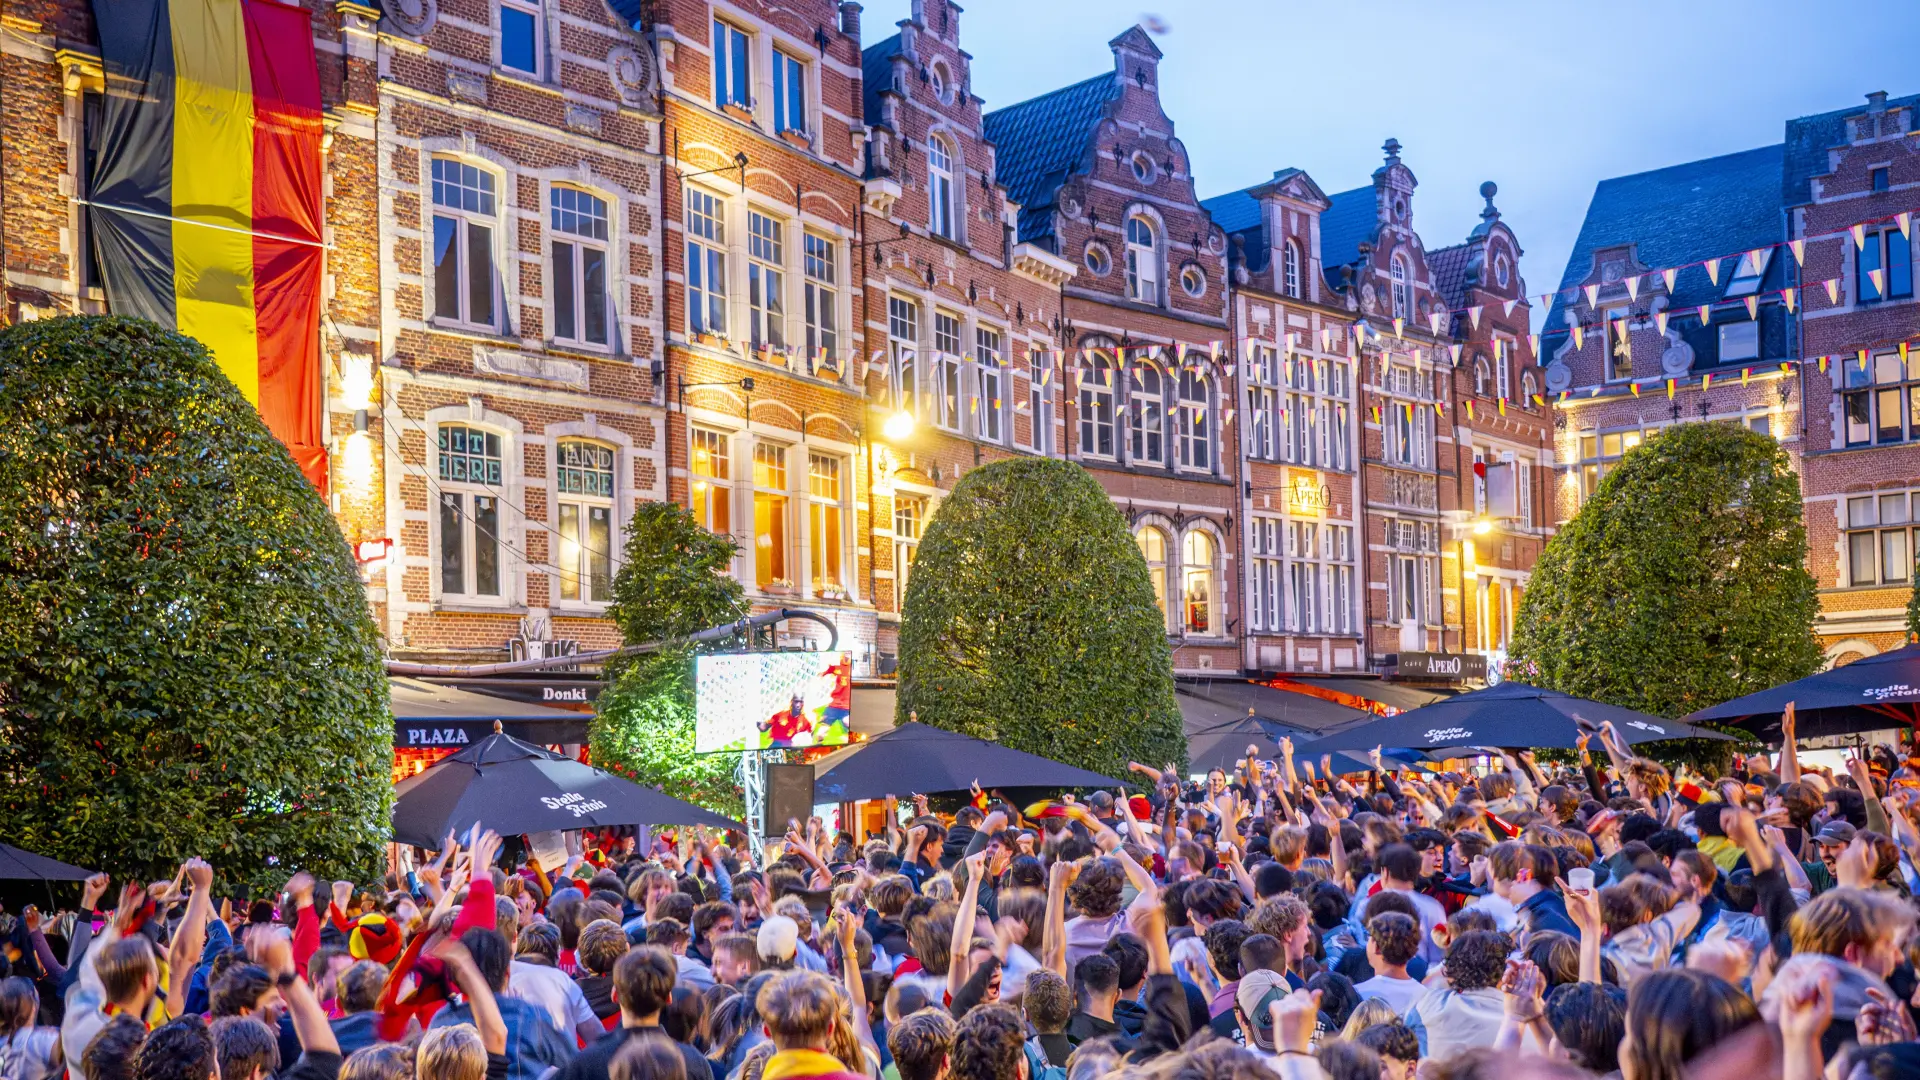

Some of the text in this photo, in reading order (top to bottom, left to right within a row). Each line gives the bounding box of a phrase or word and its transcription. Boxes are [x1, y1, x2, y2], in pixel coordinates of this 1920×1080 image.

[438, 430, 483, 453] SIT
[567, 447, 611, 468] AND
[1427, 656, 1461, 674] APERO
[543, 687, 587, 700] Donki
[1862, 684, 1909, 697] Stella
[408, 728, 469, 744] PLAZA
[1423, 727, 1464, 738] Stella
[1428, 731, 1473, 743] Artois
[540, 792, 585, 809] Stella
[565, 799, 607, 817] Artois
